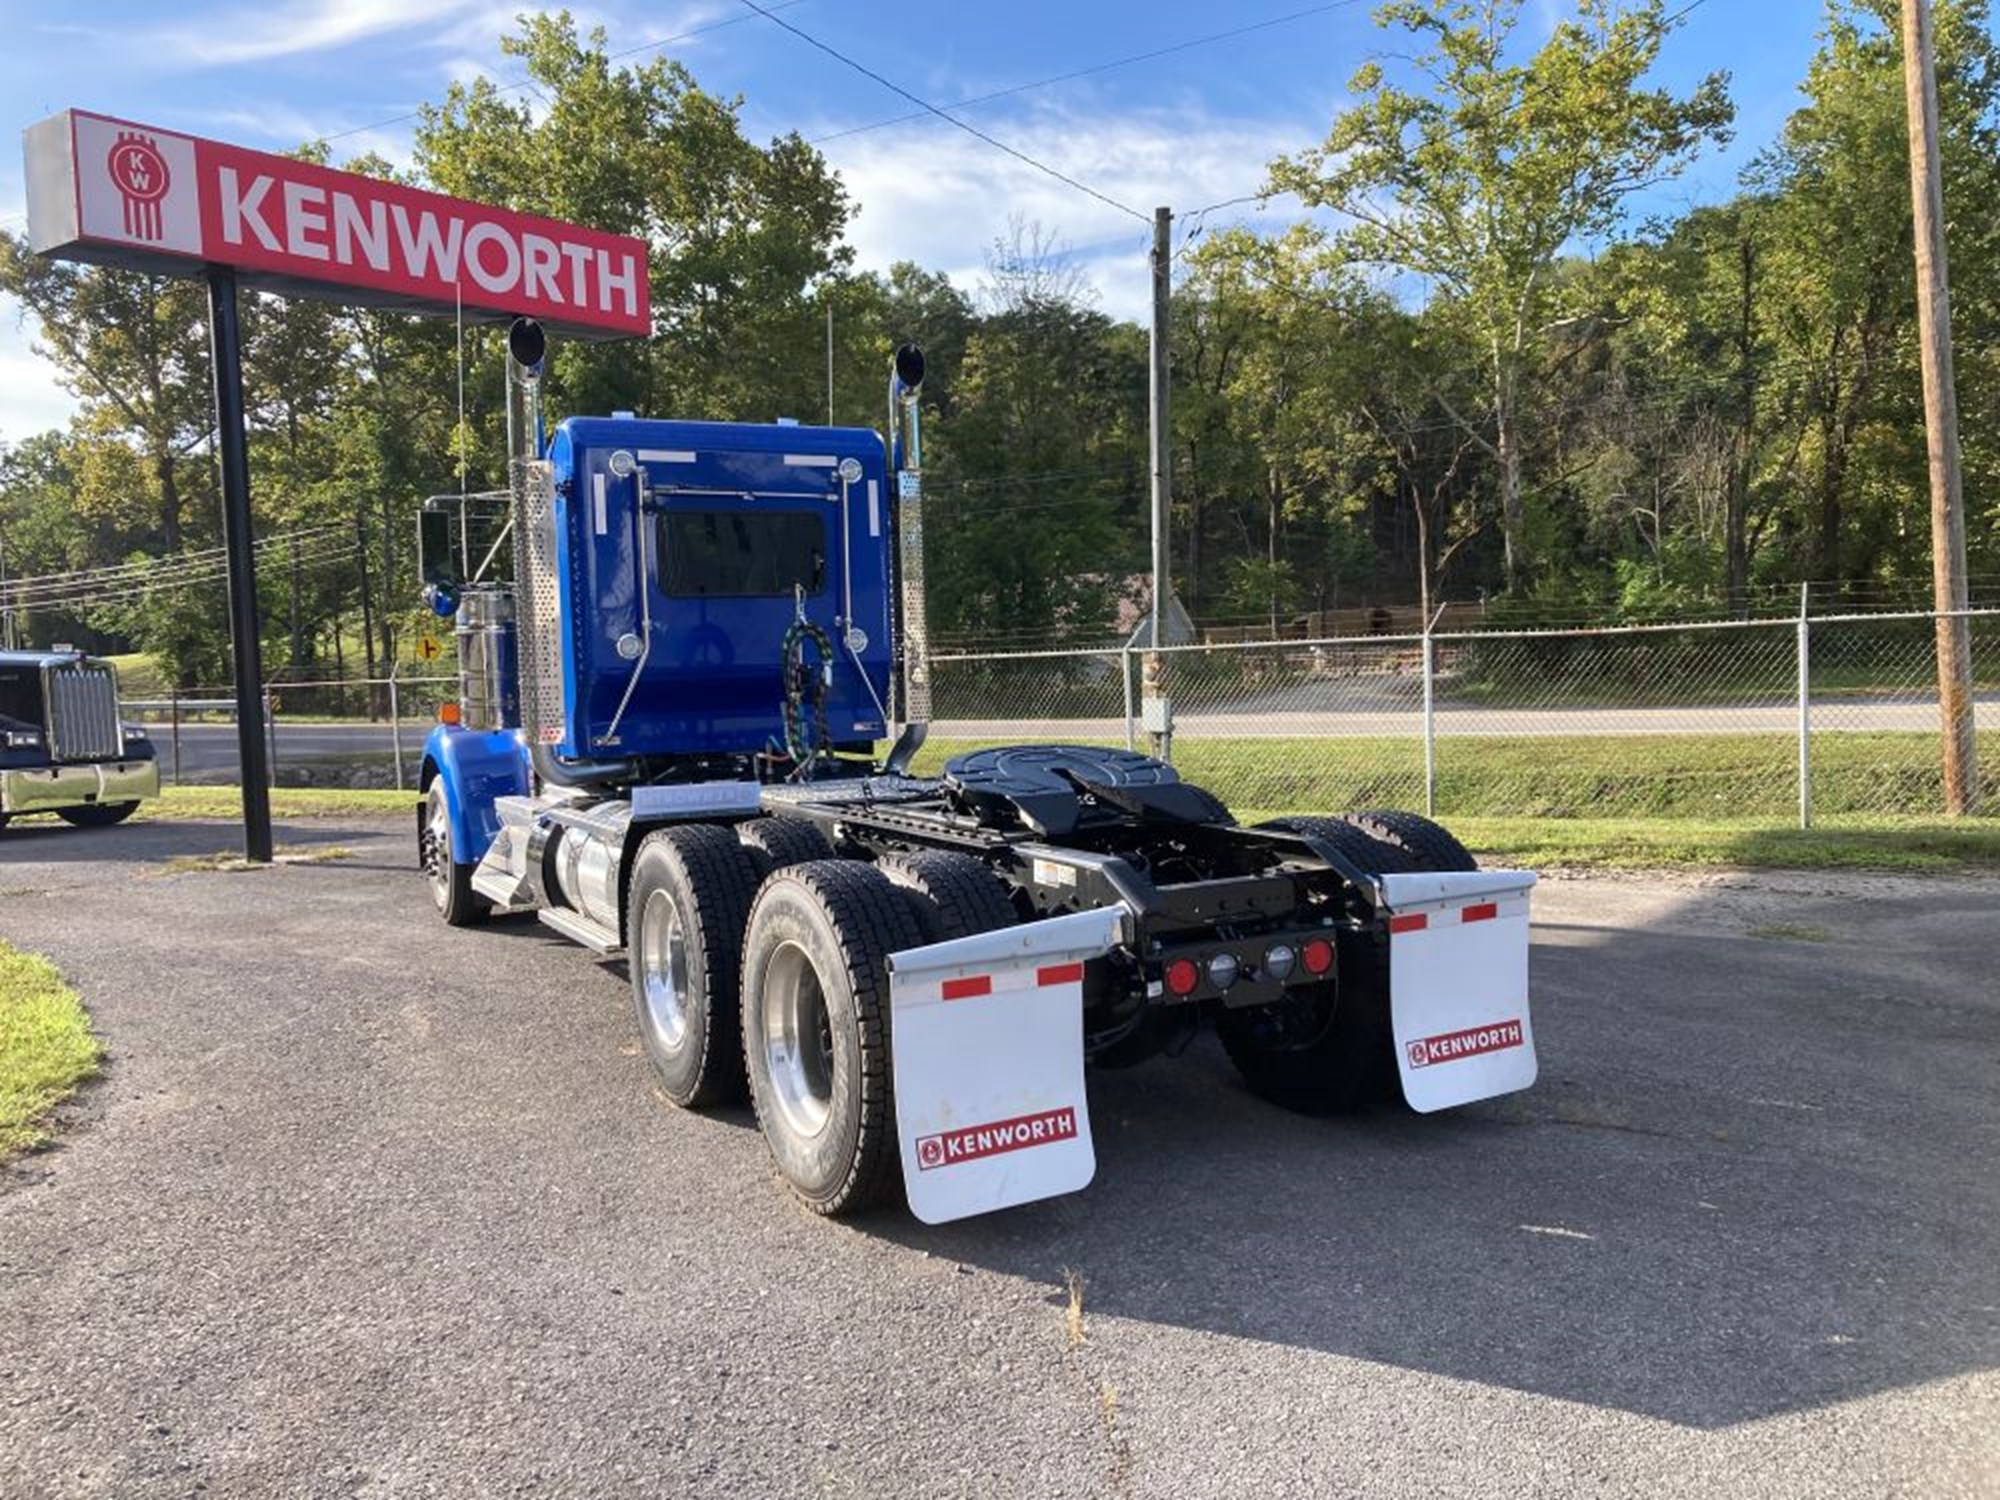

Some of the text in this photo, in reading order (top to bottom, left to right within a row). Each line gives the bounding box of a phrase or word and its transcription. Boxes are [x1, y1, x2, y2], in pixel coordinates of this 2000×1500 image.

[219, 166, 638, 317] KENWORTH
[1428, 1025, 1520, 1059] KENWORTH
[947, 1114, 1073, 1157] KENWORTH
